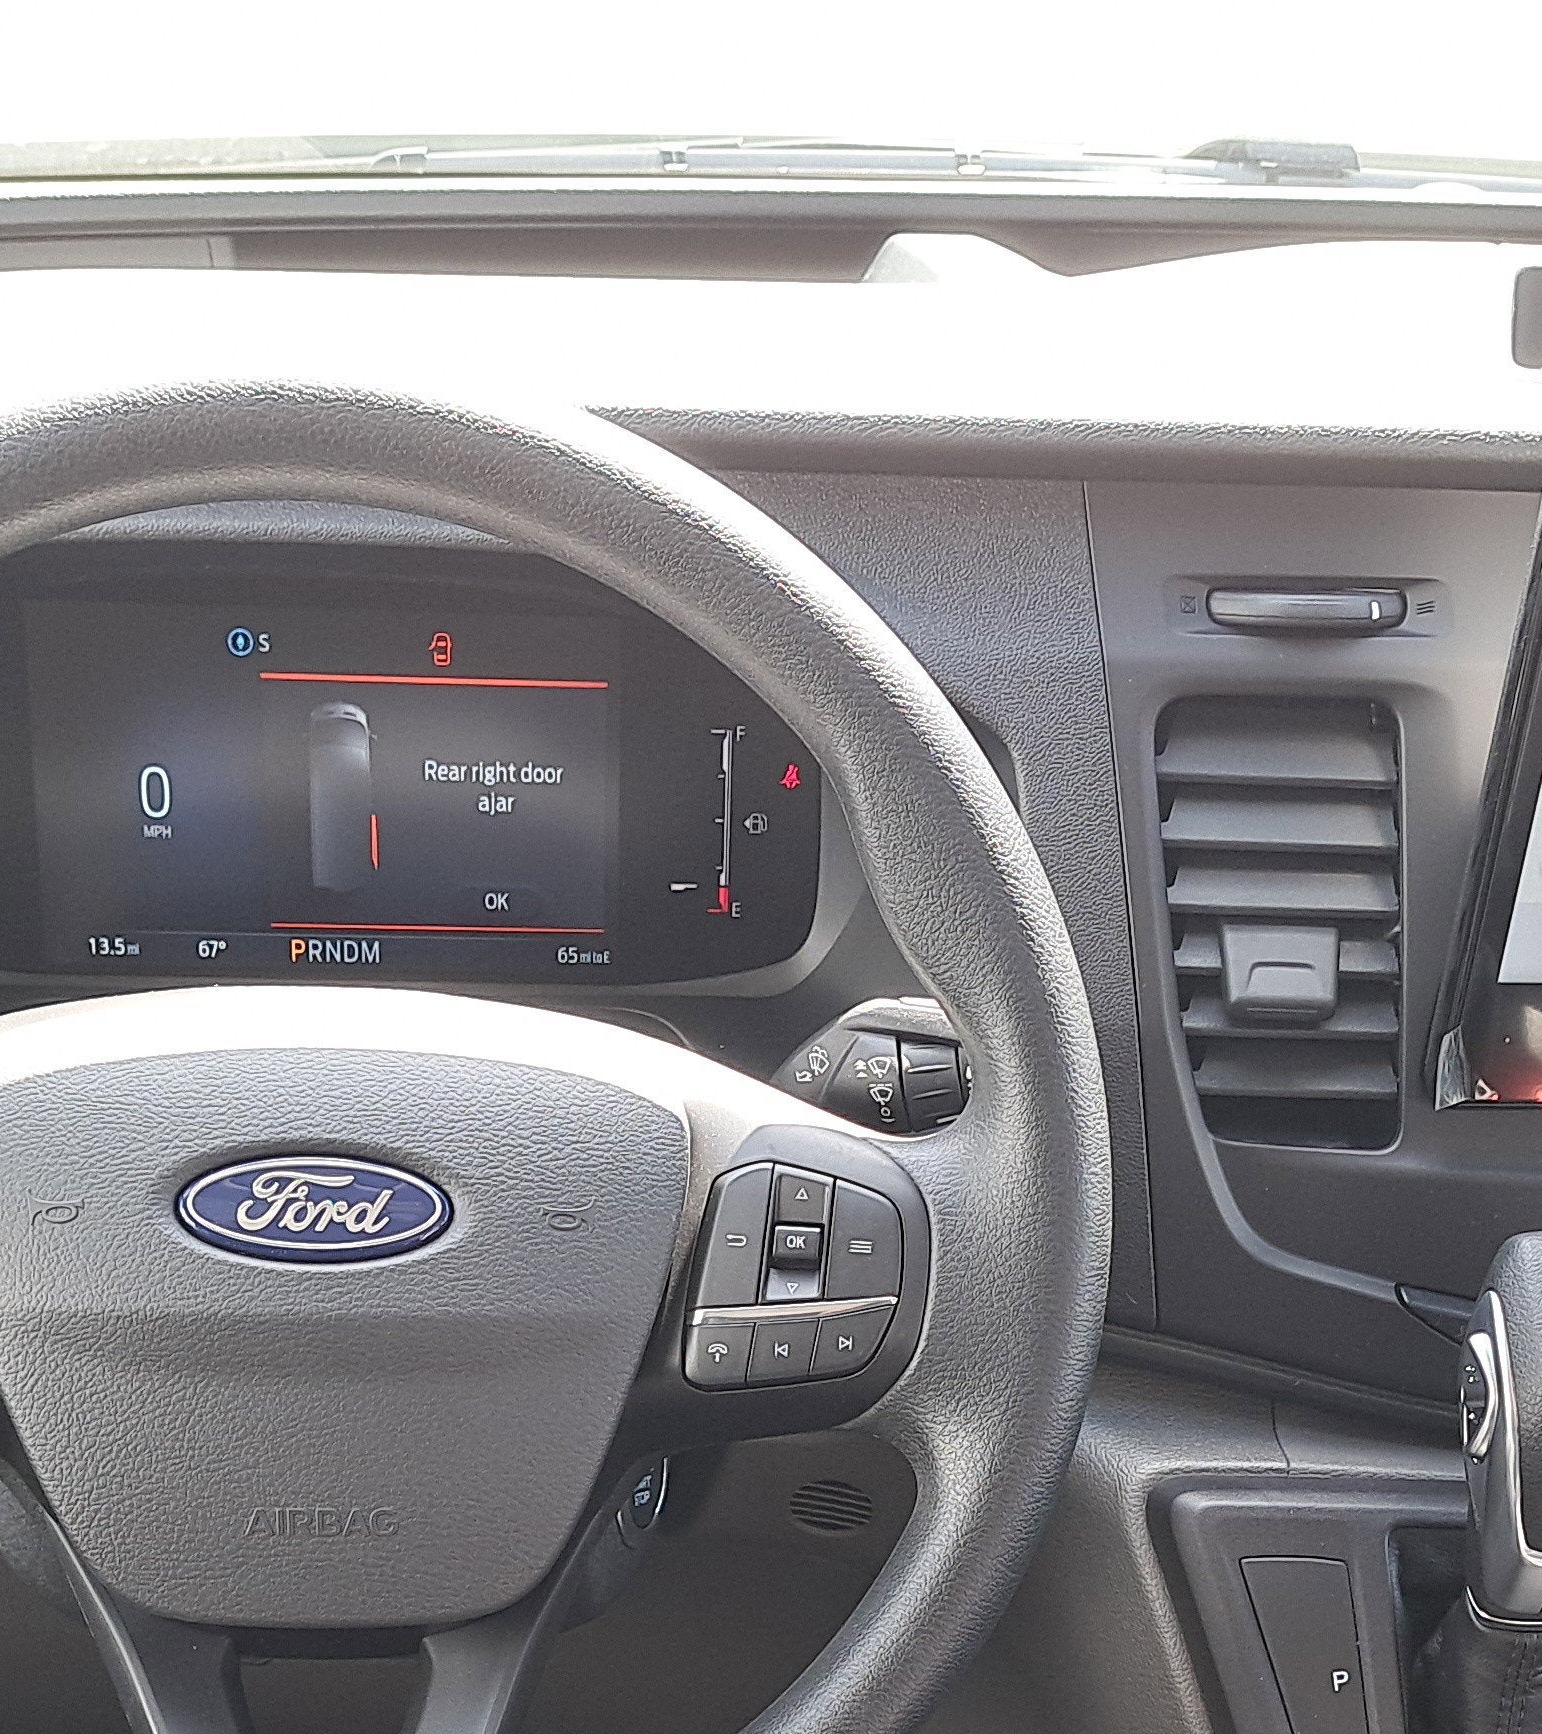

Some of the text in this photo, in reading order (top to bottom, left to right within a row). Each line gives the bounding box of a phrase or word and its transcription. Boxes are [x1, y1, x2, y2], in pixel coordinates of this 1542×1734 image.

[424, 759, 564, 786] Rear right door
[140, 766, 170, 818] 0
[478, 791, 516, 816] ajar
[143, 824, 172, 839] MPH
[484, 892, 510, 911] OK
[235, 1169, 391, 1235] Ford
[786, 1235, 806, 1250] OK
[242, 1506, 400, 1537] AIRBAG
